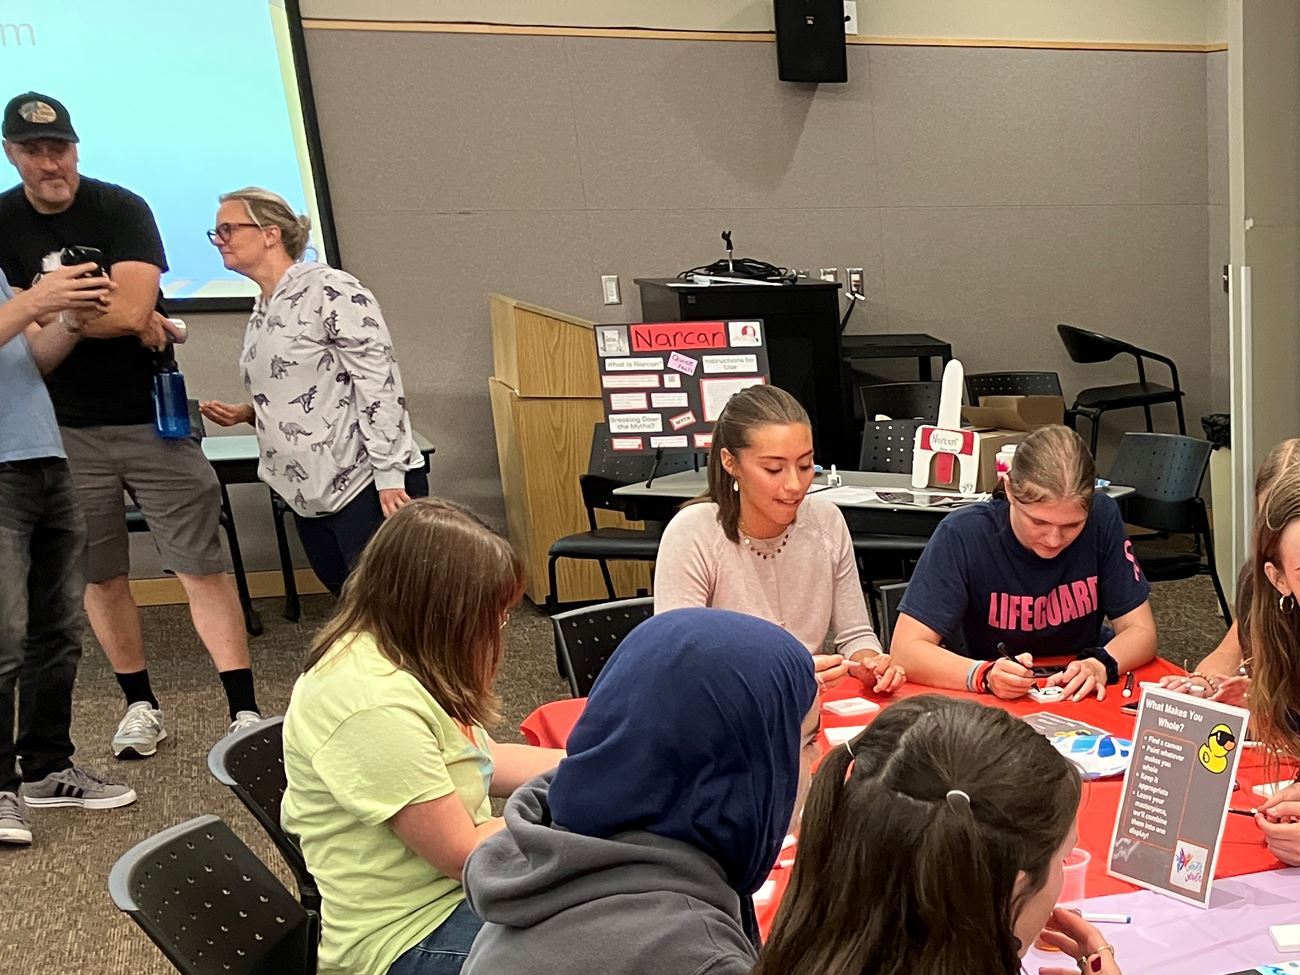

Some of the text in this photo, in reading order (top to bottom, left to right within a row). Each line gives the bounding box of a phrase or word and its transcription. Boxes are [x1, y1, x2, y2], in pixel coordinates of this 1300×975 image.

[634, 328, 723, 349] Narcan
[1146, 698, 1203, 722] What Makes You
[1158, 717, 1185, 732] Whole?
[1148, 735, 1160, 745] Find
[1164, 741, 1183, 752] canvas
[1144, 755, 1172, 768] makes you
[1160, 749, 1185, 762] whatever
[1142, 764, 1159, 774] whole
[1140, 772, 1154, 783] Keep
[1138, 782, 1169, 797] appropriate
[1136, 790, 1165, 805] Leave your
[1130, 818, 1144, 828] them
[1156, 826, 1166, 835] one
[1145, 813, 1168, 826] combine
